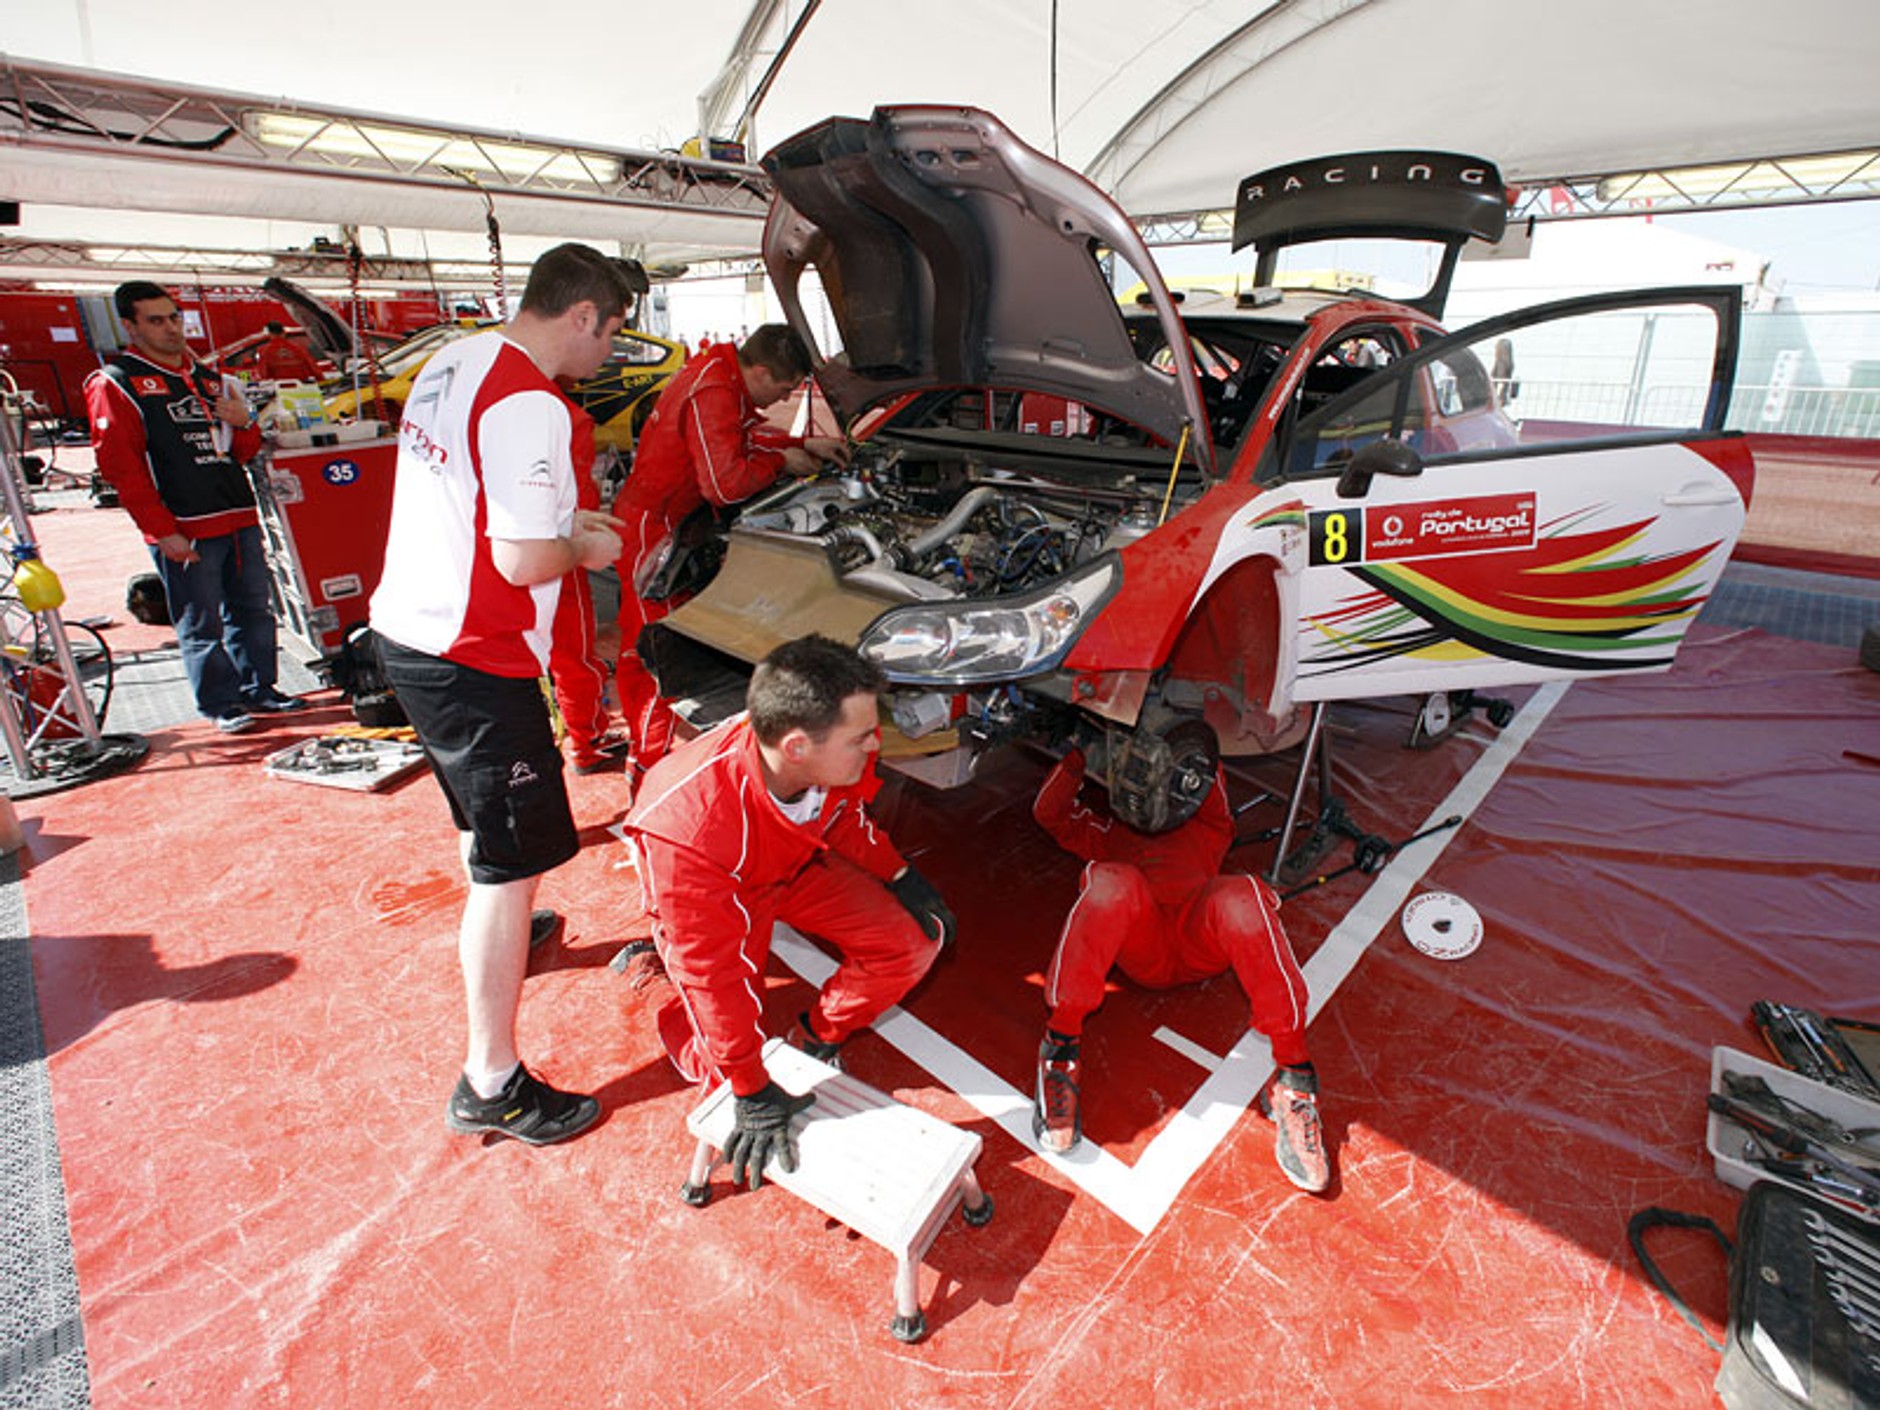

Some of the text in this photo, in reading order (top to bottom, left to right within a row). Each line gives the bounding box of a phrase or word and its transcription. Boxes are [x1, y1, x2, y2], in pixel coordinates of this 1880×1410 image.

[1247, 164, 1486, 200] RACING
[328, 464, 354, 481] 35
[1323, 513, 1348, 563] 8
[1419, 511, 1530, 537] Portugal
